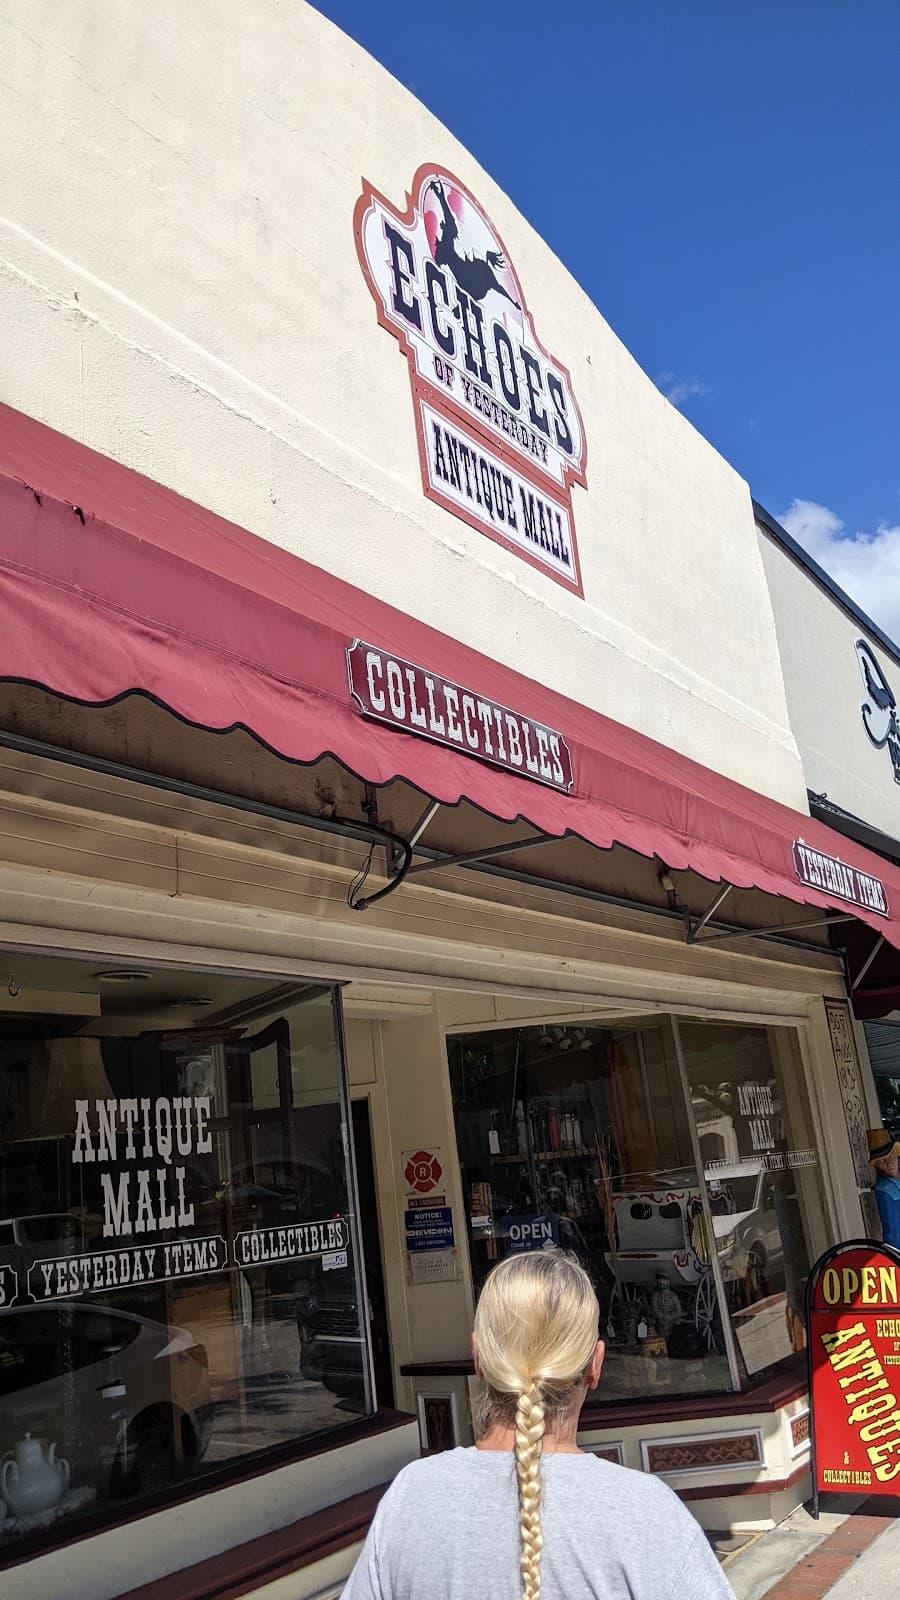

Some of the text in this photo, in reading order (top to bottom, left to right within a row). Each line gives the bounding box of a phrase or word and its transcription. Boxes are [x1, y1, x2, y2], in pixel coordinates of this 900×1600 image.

[383, 219, 574, 455] ECHOES
[433, 354, 549, 464] OF YESTERDAY
[432, 421, 570, 567] ANTIQUE MALL
[366, 651, 564, 784] COLLECTIBLES
[797, 845, 886, 912] YESTERDAY ITEMS
[71, 1097, 213, 1165] ANTIQUE
[419, 1167, 427, 1177] R
[100, 1167, 195, 1238] MALL
[414, 1211, 442, 1220] NOTICE!
[241, 1222, 344, 1263] COLLECTIBLES
[509, 1222, 553, 1241] OPEN
[41, 1249, 156, 1297] YESTERDAY
[164, 1240, 218, 1277] ITEMS
[822, 1266, 897, 1305] OPEN
[823, 1469, 872, 1486] COLLECTIBLES
[843, 1451, 850, 1465] &
